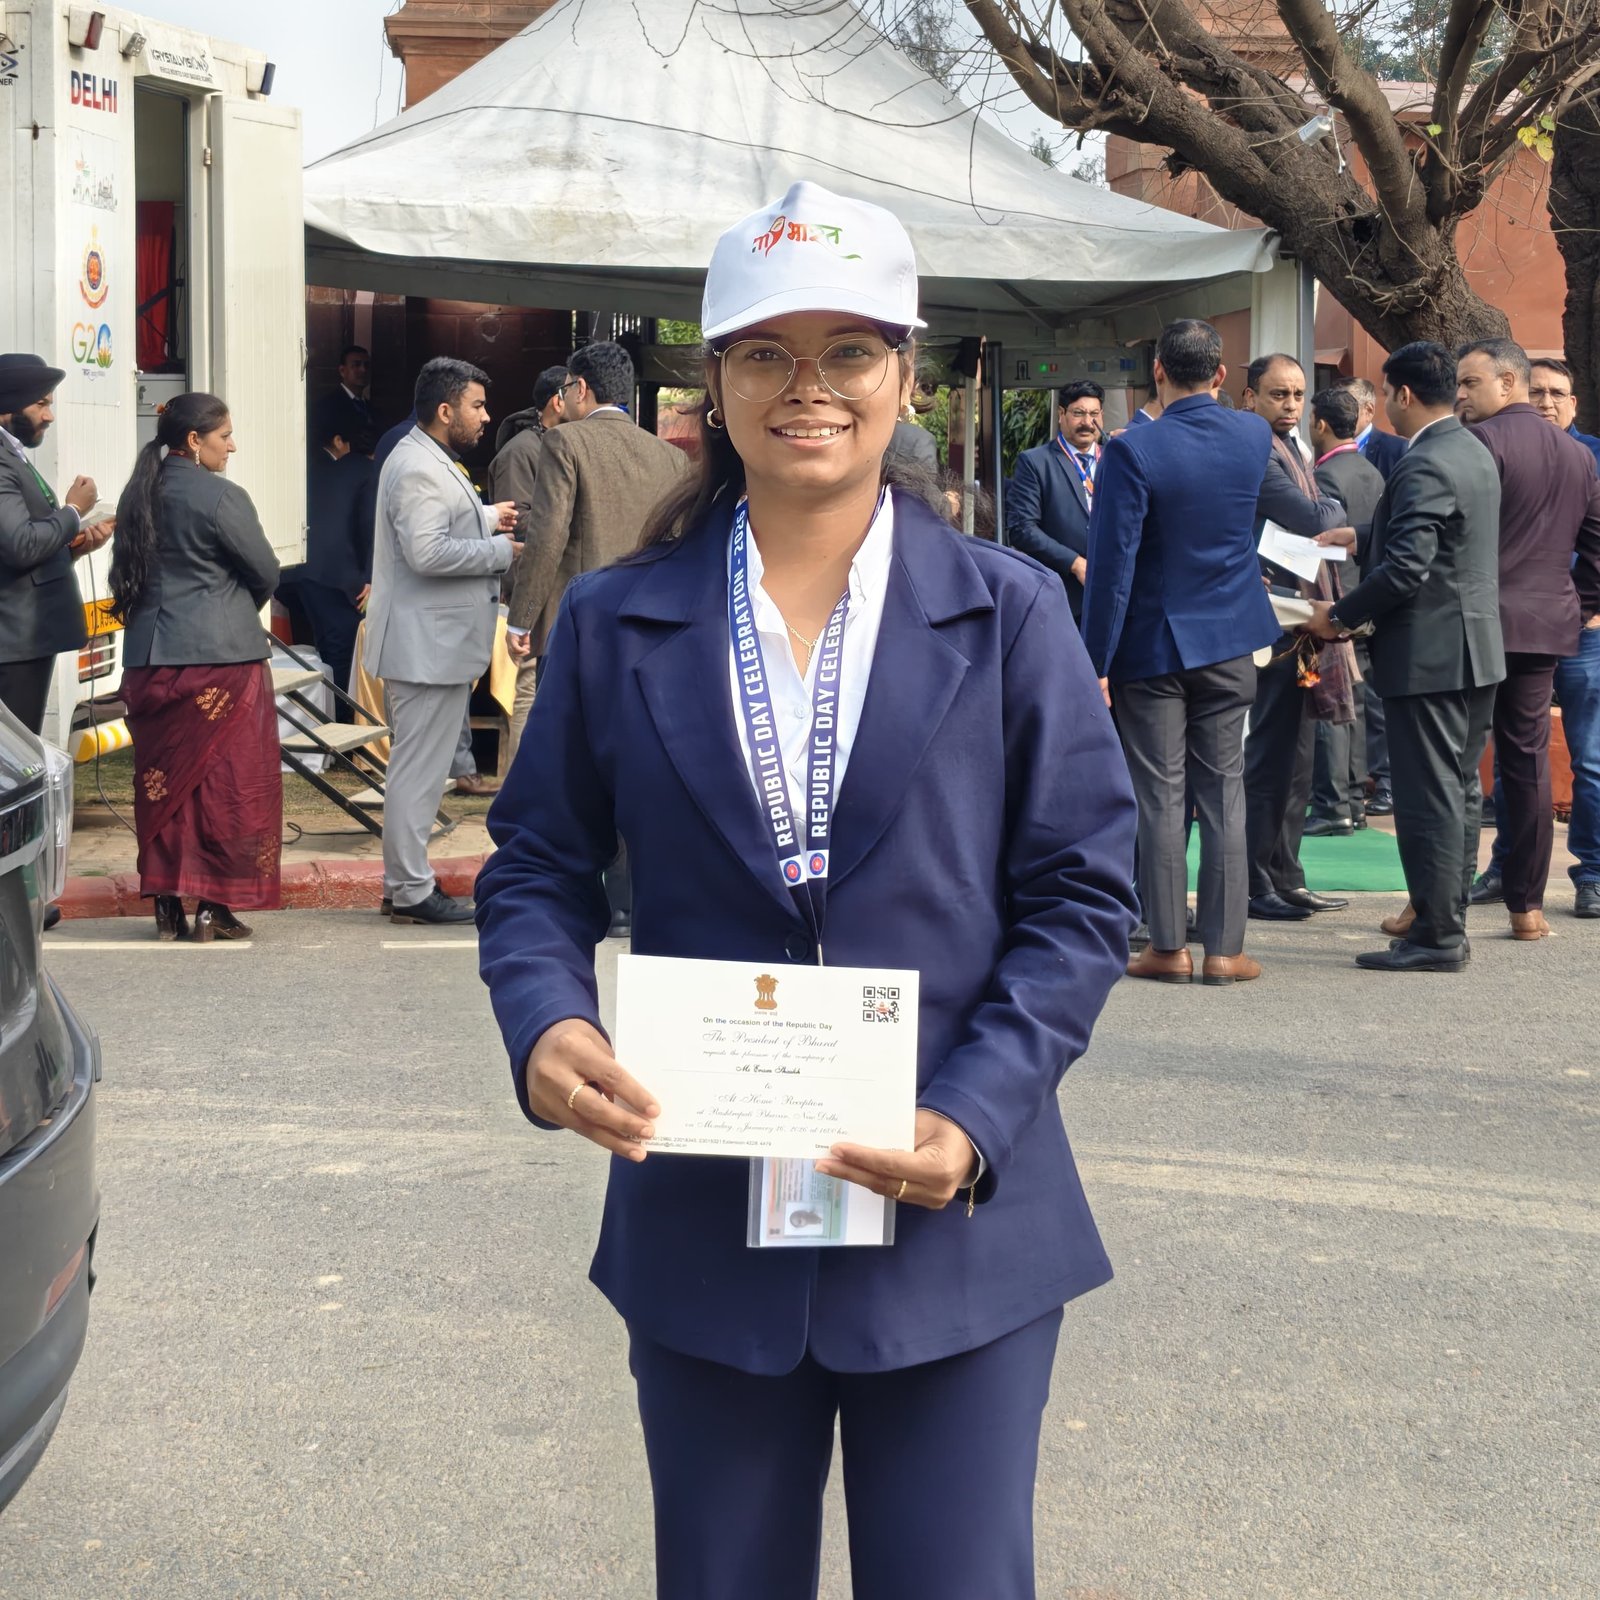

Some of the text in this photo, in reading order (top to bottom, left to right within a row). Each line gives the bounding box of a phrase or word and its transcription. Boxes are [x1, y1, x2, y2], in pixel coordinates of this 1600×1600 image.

[71, 70, 117, 113] DELHI
[72, 322, 113, 368] G20
[733, 568, 764, 696] CELEBRATION
[749, 702, 773, 741] DAY
[811, 592, 848, 837] REPUBLIC DAY CELEBRA
[757, 744, 794, 847] REPUBLIC
[703, 1030, 838, 1048] The President of Bharat
[786, 1021, 816, 1029] Republic
[819, 1022, 832, 1030] Day
[781, 1094, 824, 1108] Reception
